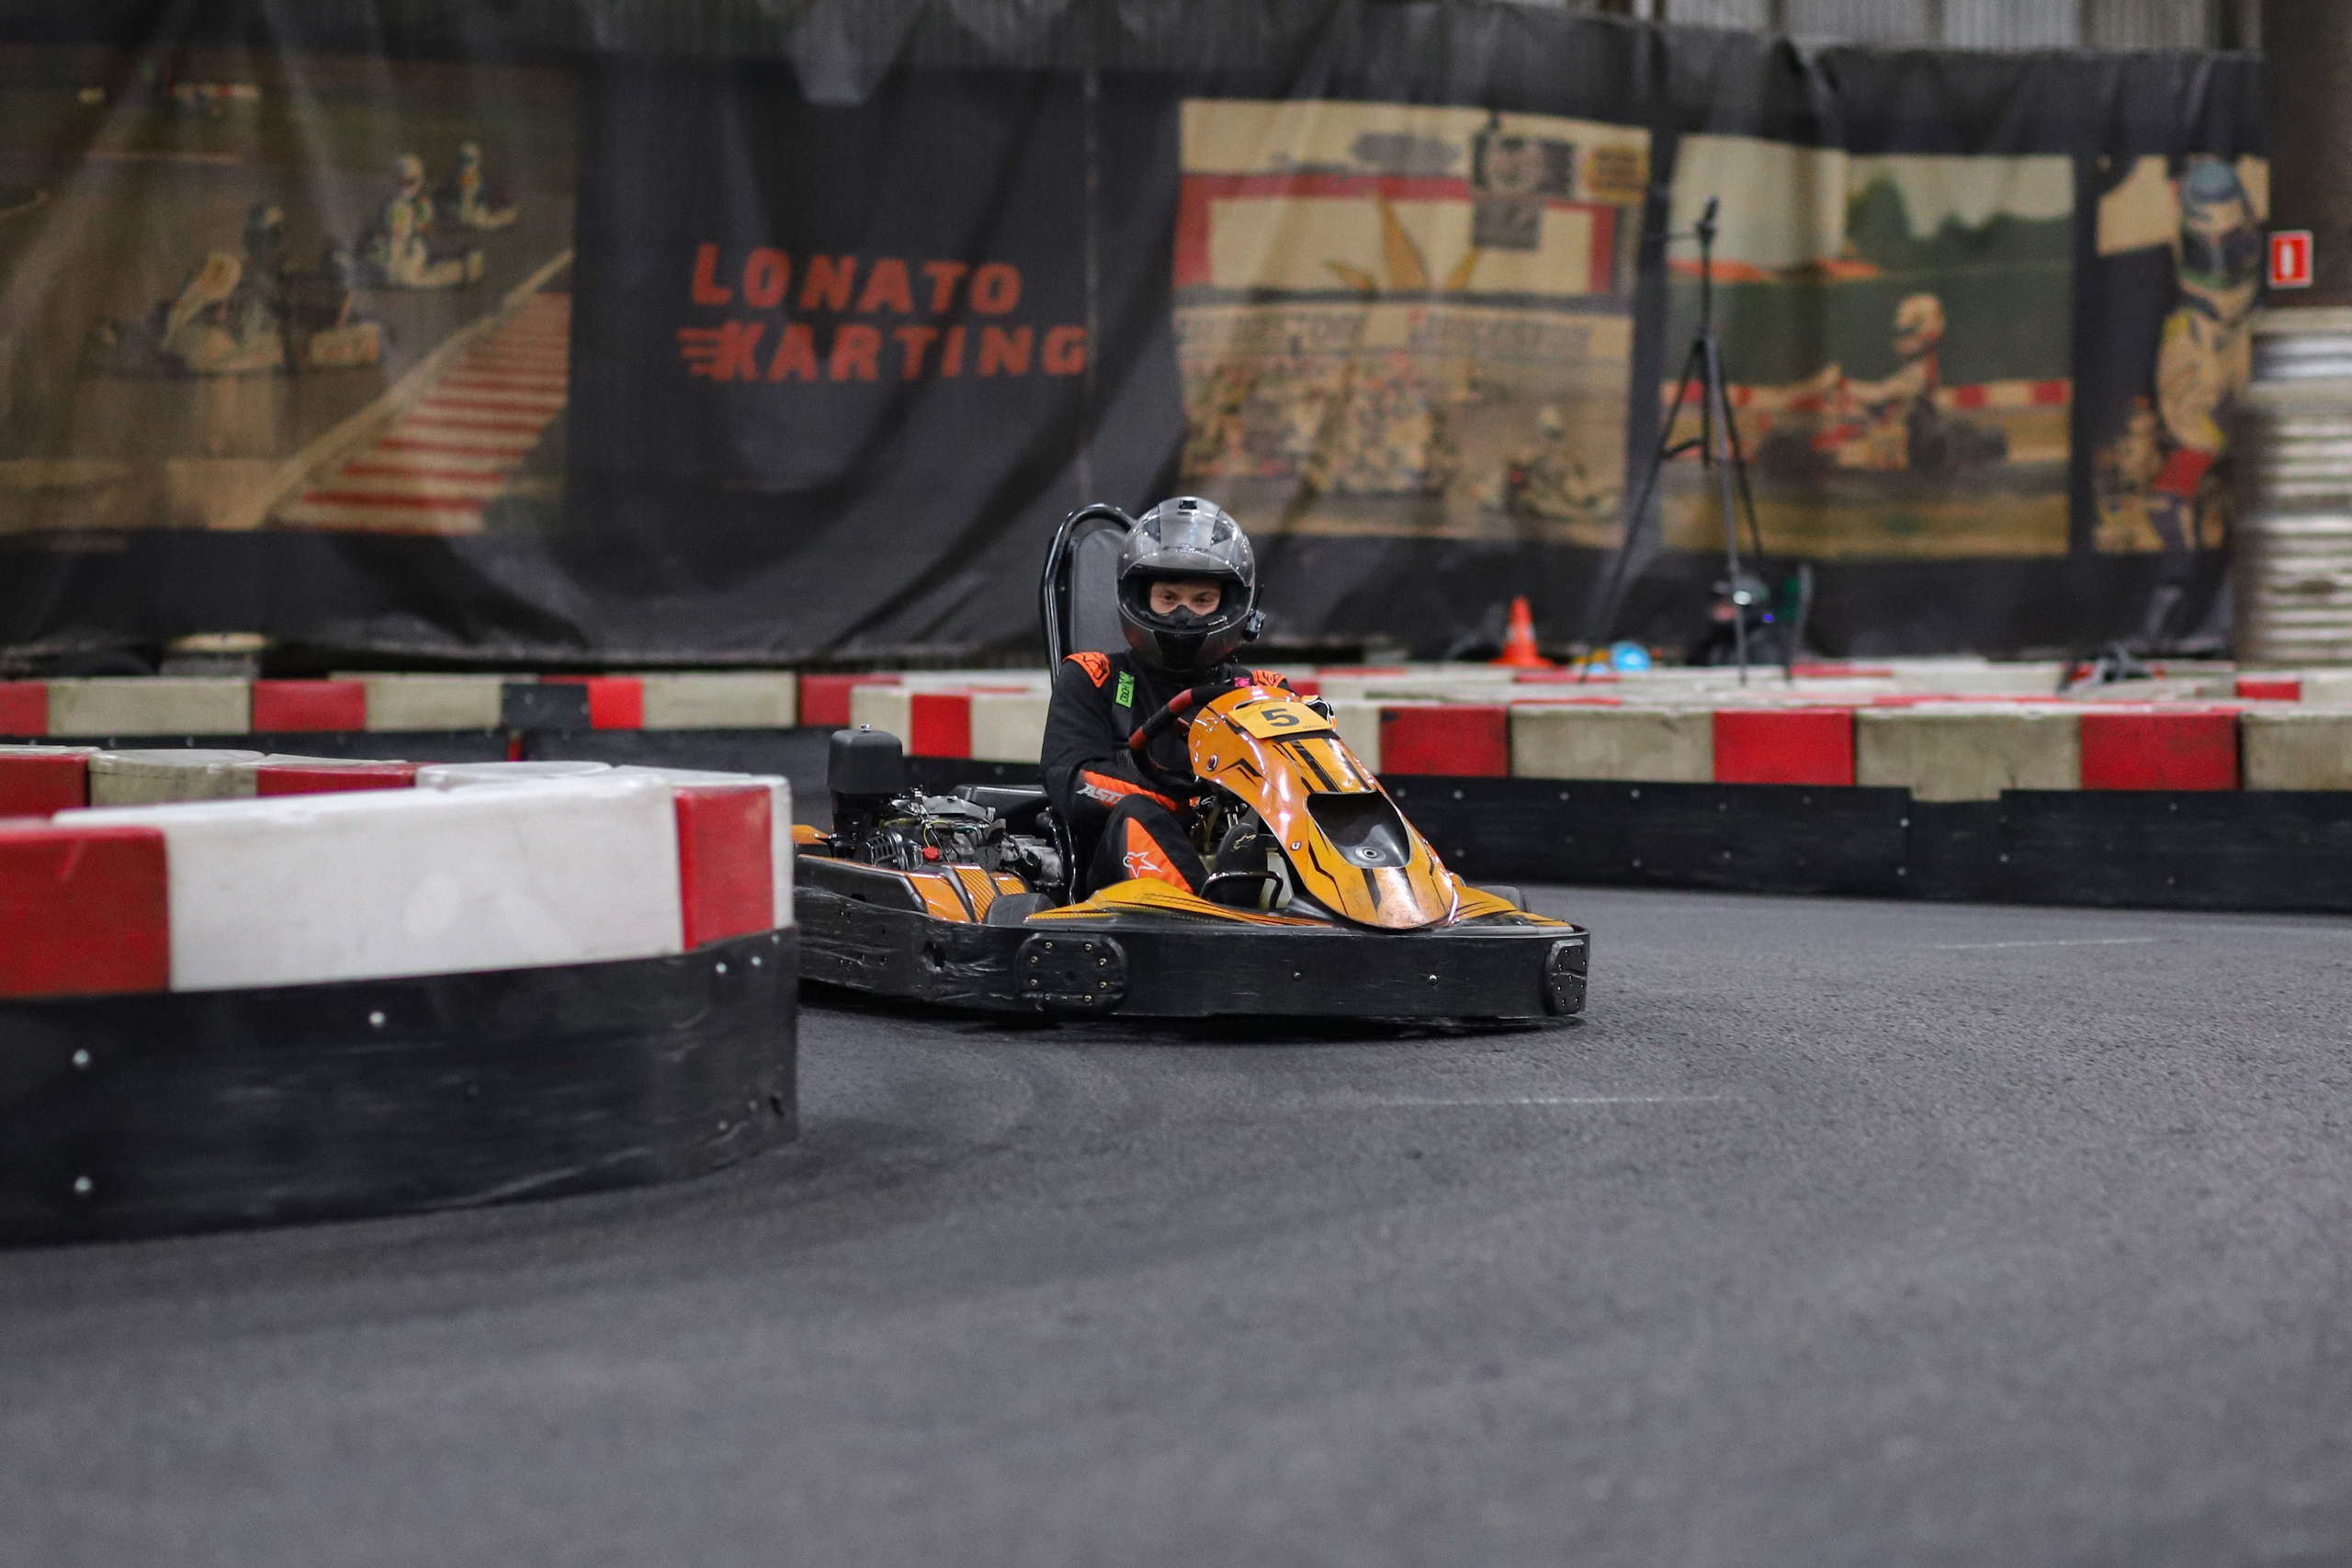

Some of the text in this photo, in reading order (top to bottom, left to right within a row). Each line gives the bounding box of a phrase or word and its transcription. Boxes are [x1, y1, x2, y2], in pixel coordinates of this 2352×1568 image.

[692, 243, 1023, 315] LONATO
[676, 321, 1088, 382] KARTING
[1261, 708, 1300, 727] 5
